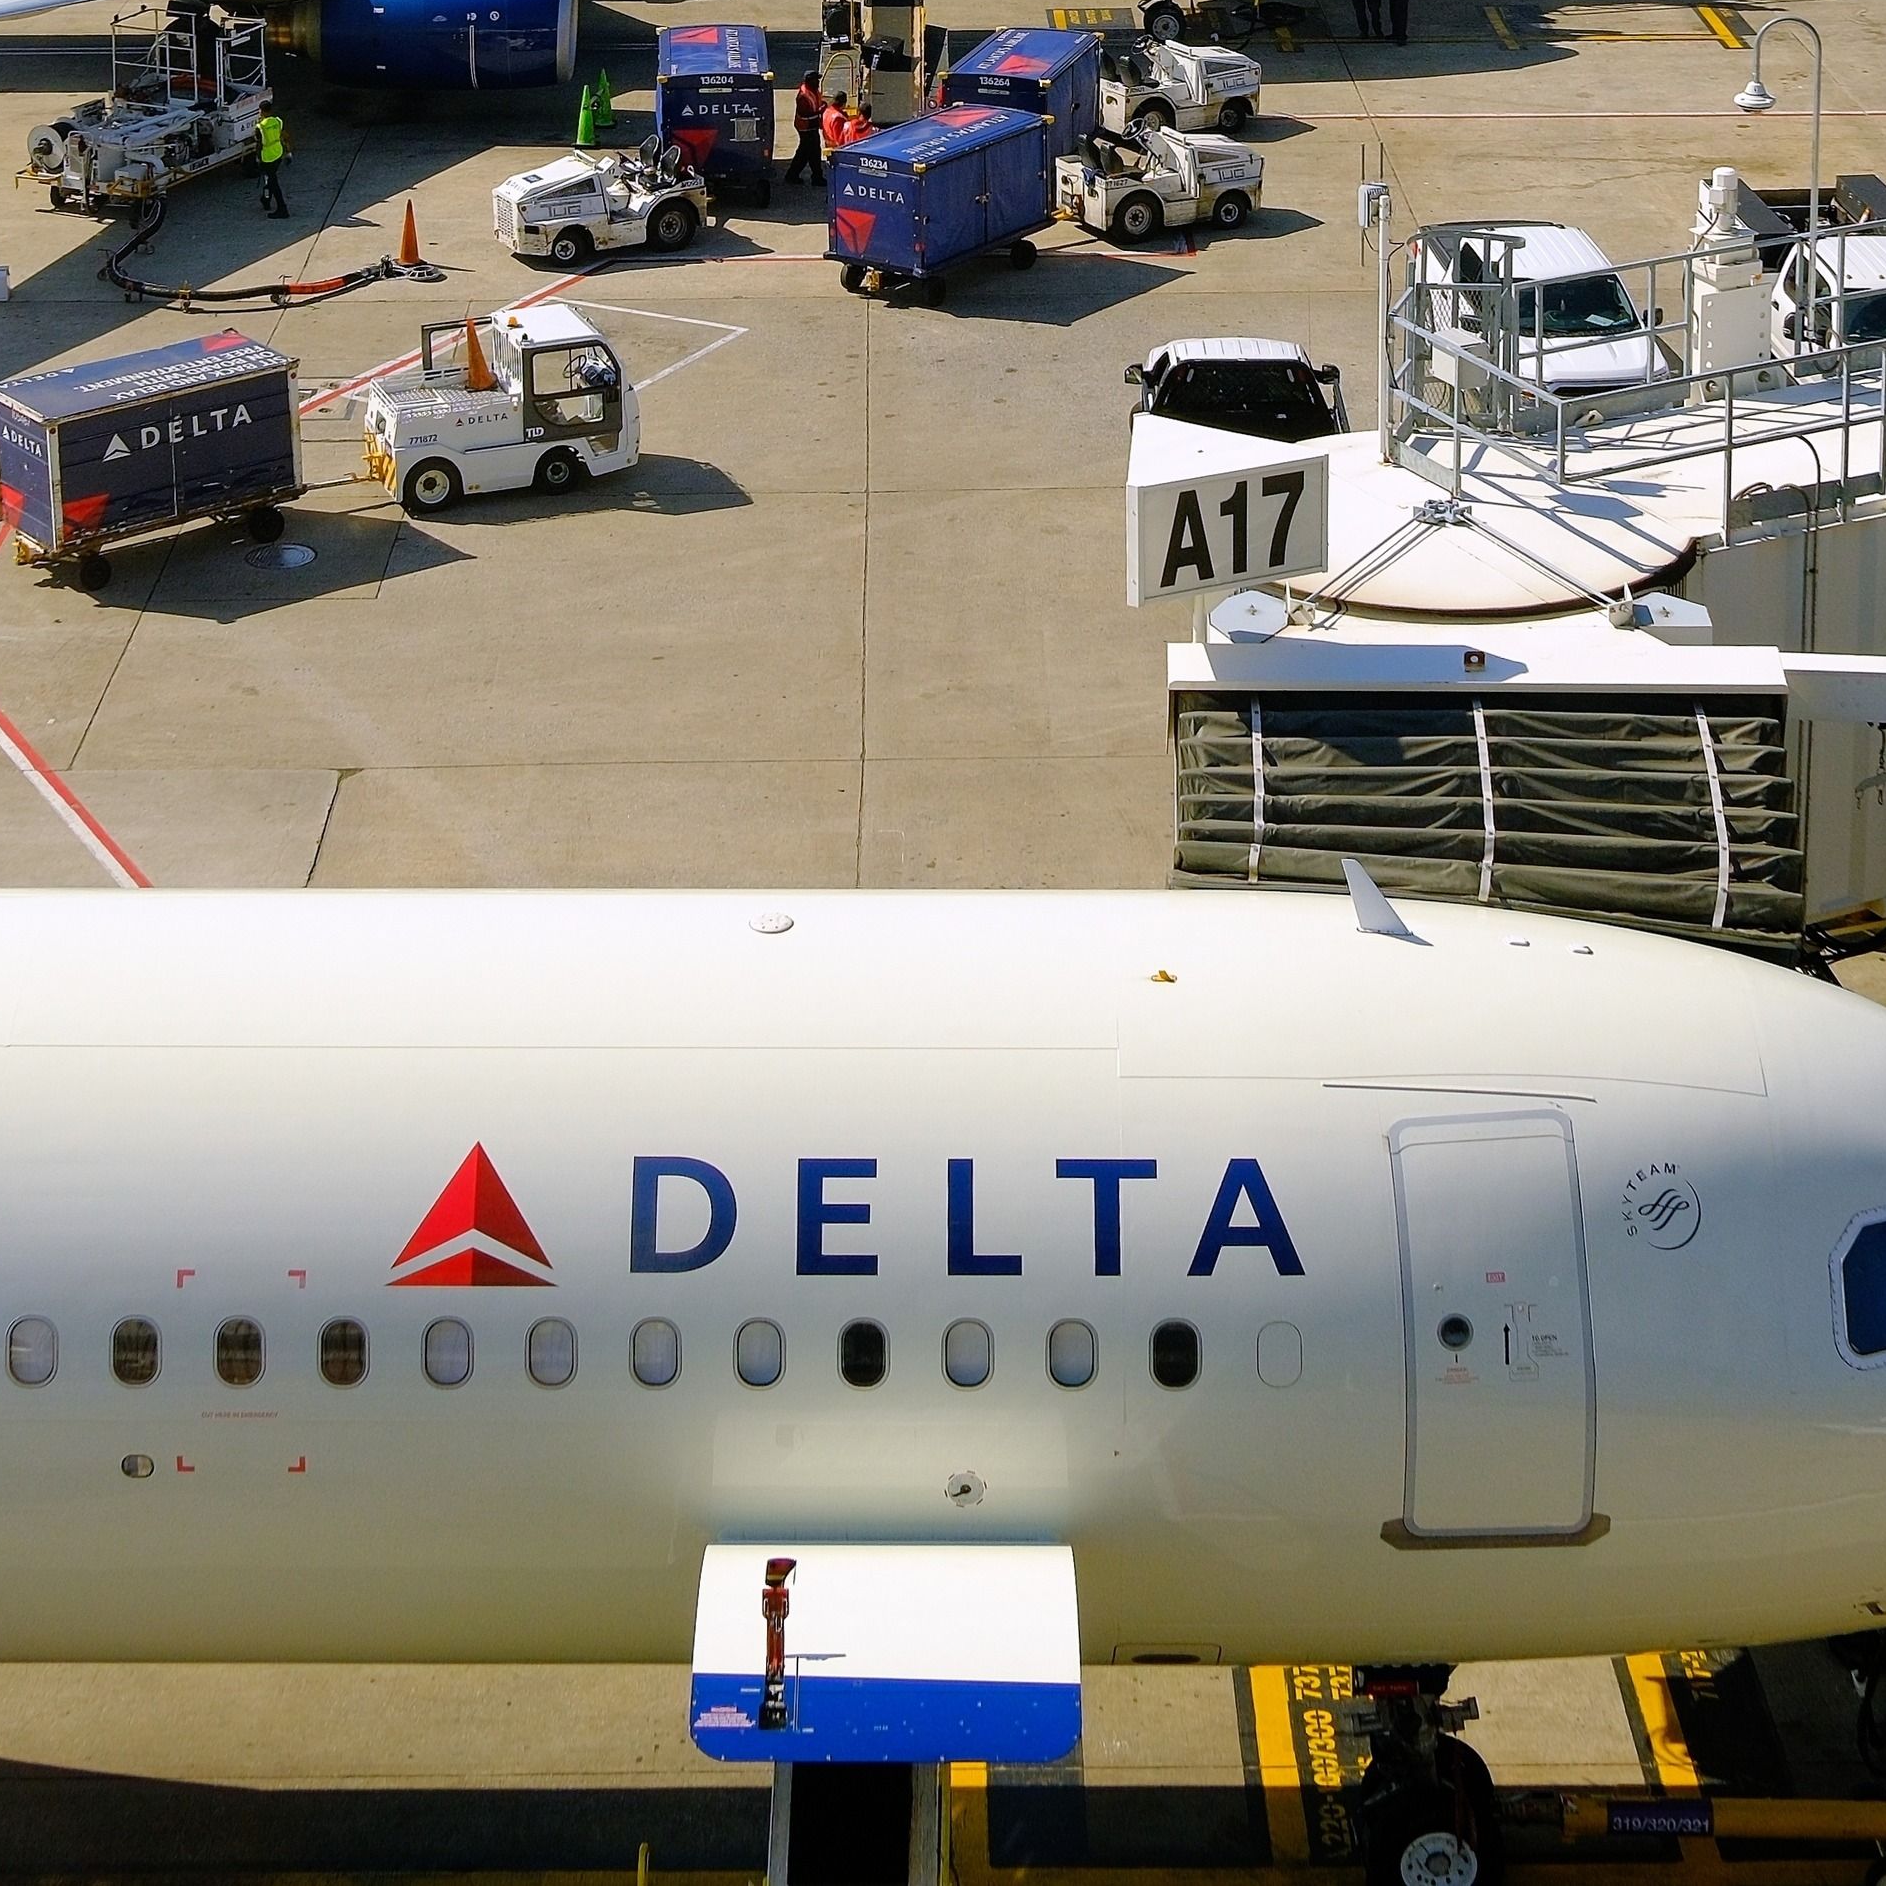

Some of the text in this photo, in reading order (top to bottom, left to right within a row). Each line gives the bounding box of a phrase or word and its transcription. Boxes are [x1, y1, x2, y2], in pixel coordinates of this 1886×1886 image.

[700, 75, 734, 85] 136204
[979, 76, 1011, 87] 136264
[698, 103, 752, 115] DELTA
[902, 135, 950, 156] AIRLINE
[860, 157, 888, 171] 136234
[857, 187, 905, 204] DELTA
[73, 345, 264, 393] FREE ENTERTAINMENT.
[183, 360, 251, 376] BOARD
[208, 363, 257, 377] BACK
[110, 385, 171, 401] RELAX
[141, 403, 253, 450] DELTA
[468, 413, 509, 425] DELTA
[409, 434, 438, 445] 771872
[526, 426, 545, 438] TLD
[10, 430, 43, 458] DELTA
[1160, 470, 1306, 588] A17
[1621, 1162, 1677, 1237] SKYTEAM
[629, 1155, 1306, 1278] DELTA
[1612, 1816, 1710, 1833] 319/320/321
